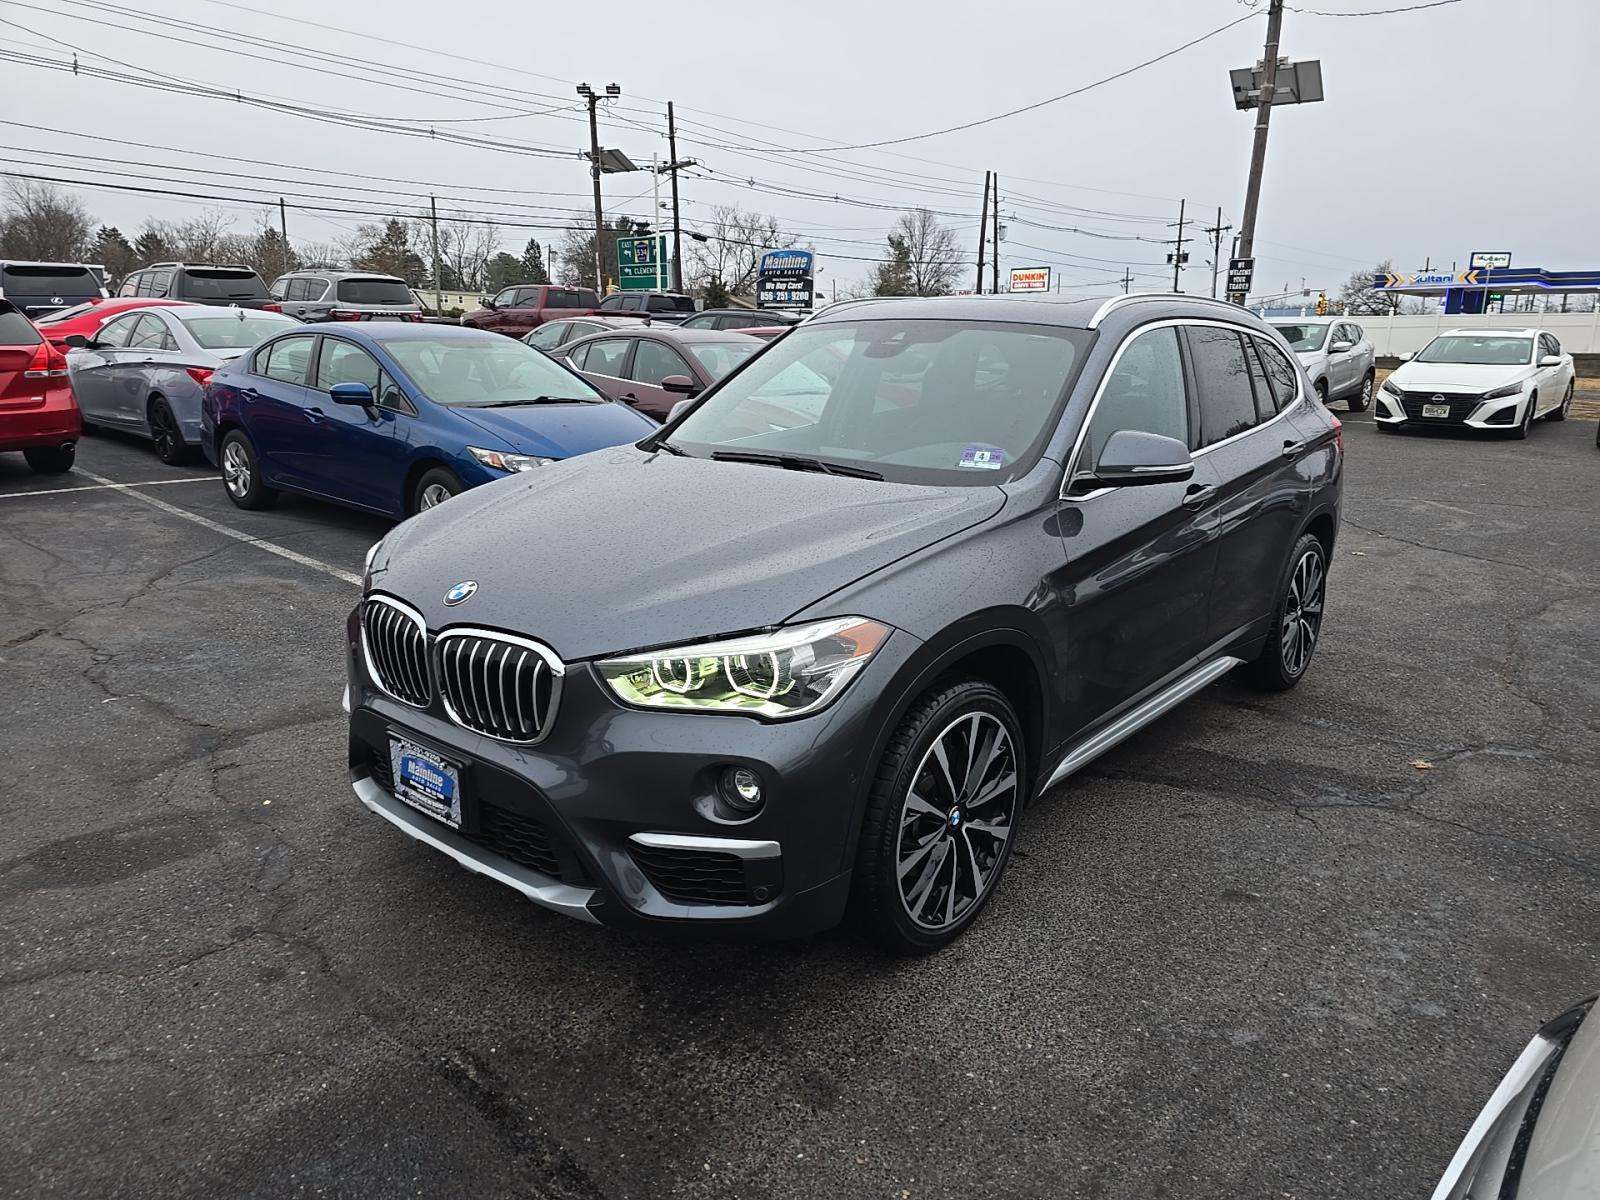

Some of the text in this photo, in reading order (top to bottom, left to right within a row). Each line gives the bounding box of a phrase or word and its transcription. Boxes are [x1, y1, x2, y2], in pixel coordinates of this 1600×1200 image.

[764, 255, 808, 268] Mainline
[1012, 272, 1047, 281] DUNKIN'
[775, 282, 787, 290] Buy
[407, 760, 444, 787] Mainline
